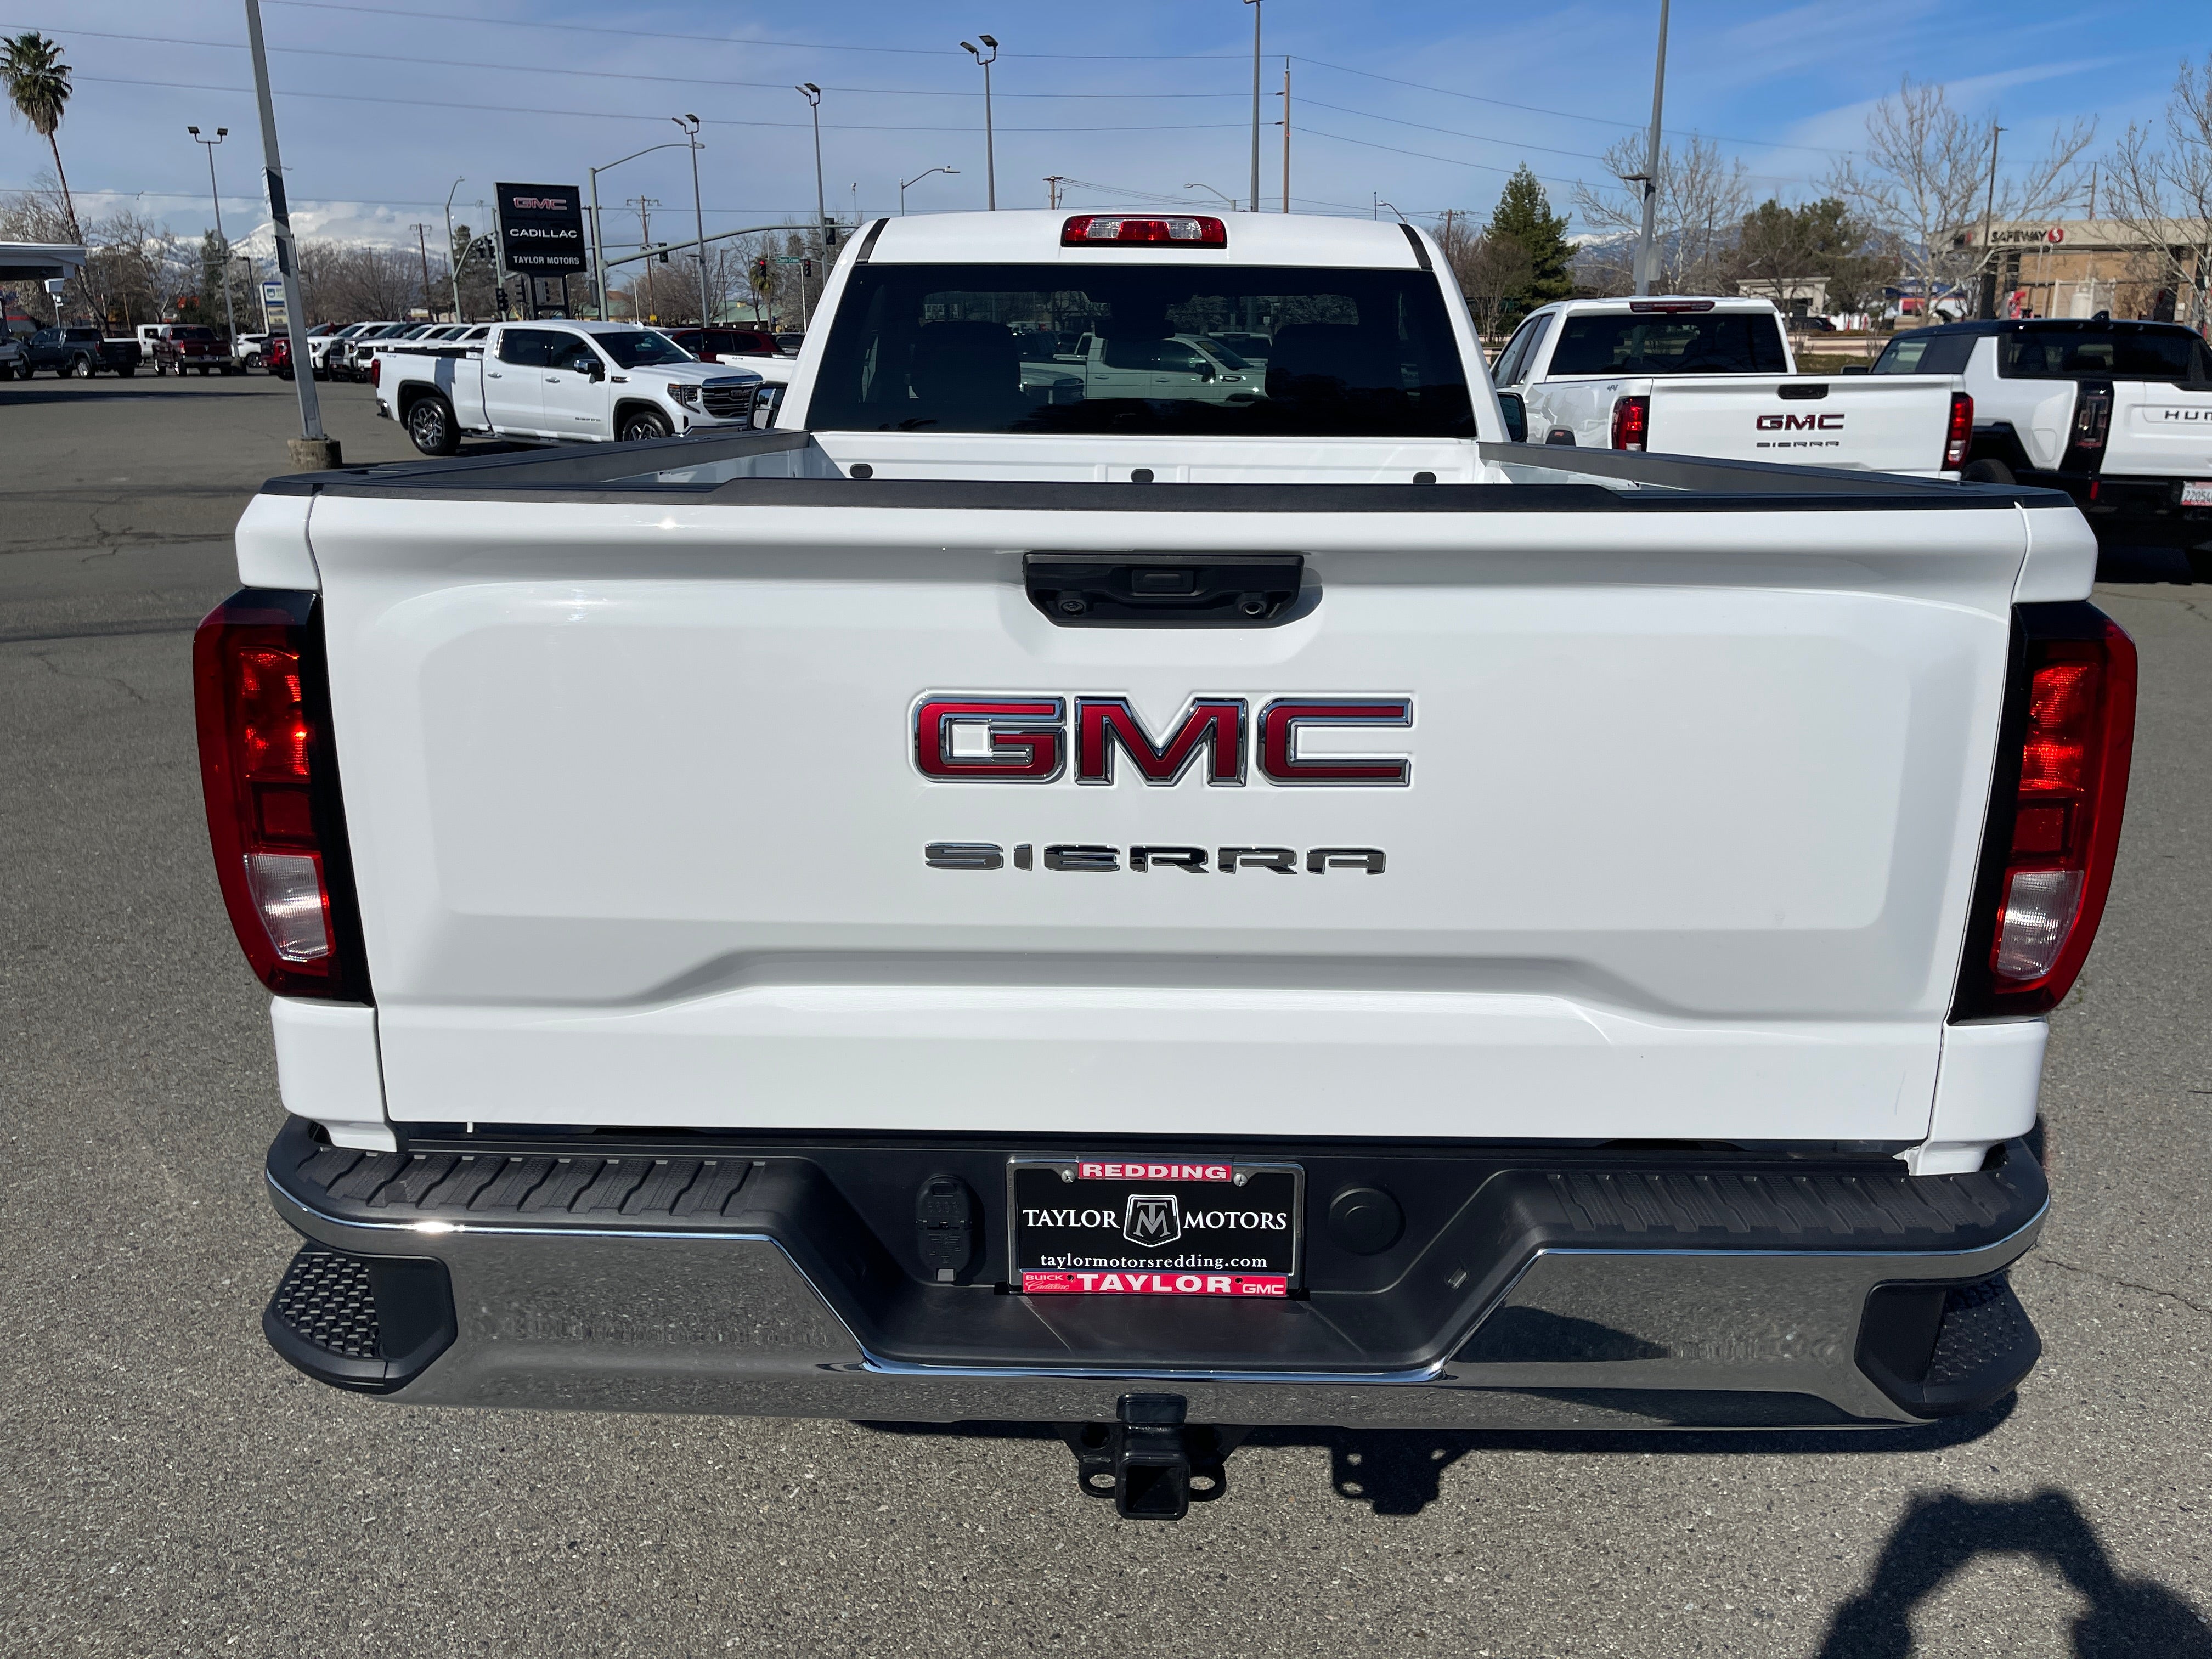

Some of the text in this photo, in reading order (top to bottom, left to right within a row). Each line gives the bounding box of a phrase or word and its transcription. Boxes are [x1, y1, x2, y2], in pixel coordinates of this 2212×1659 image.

[514, 196, 567, 211] GMC
[510, 228, 577, 238] CADILLAC
[513, 255, 579, 265] TAYLOR MOTORS
[1756, 414, 1844, 431] GMC
[913, 692, 1412, 788] GMC
[925, 842, 1386, 876] SIERRA
[1082, 1164, 1227, 1180] REDDING
[1022, 1209, 1287, 1231] TAYLOR MOTORS
[1040, 1252, 1267, 1270] taylormotorsredding.com
[1025, 1280, 1070, 1291] Cadillac
[1076, 1274, 1232, 1293] TAYLOR
[1242, 1283, 1285, 1295] GMC
